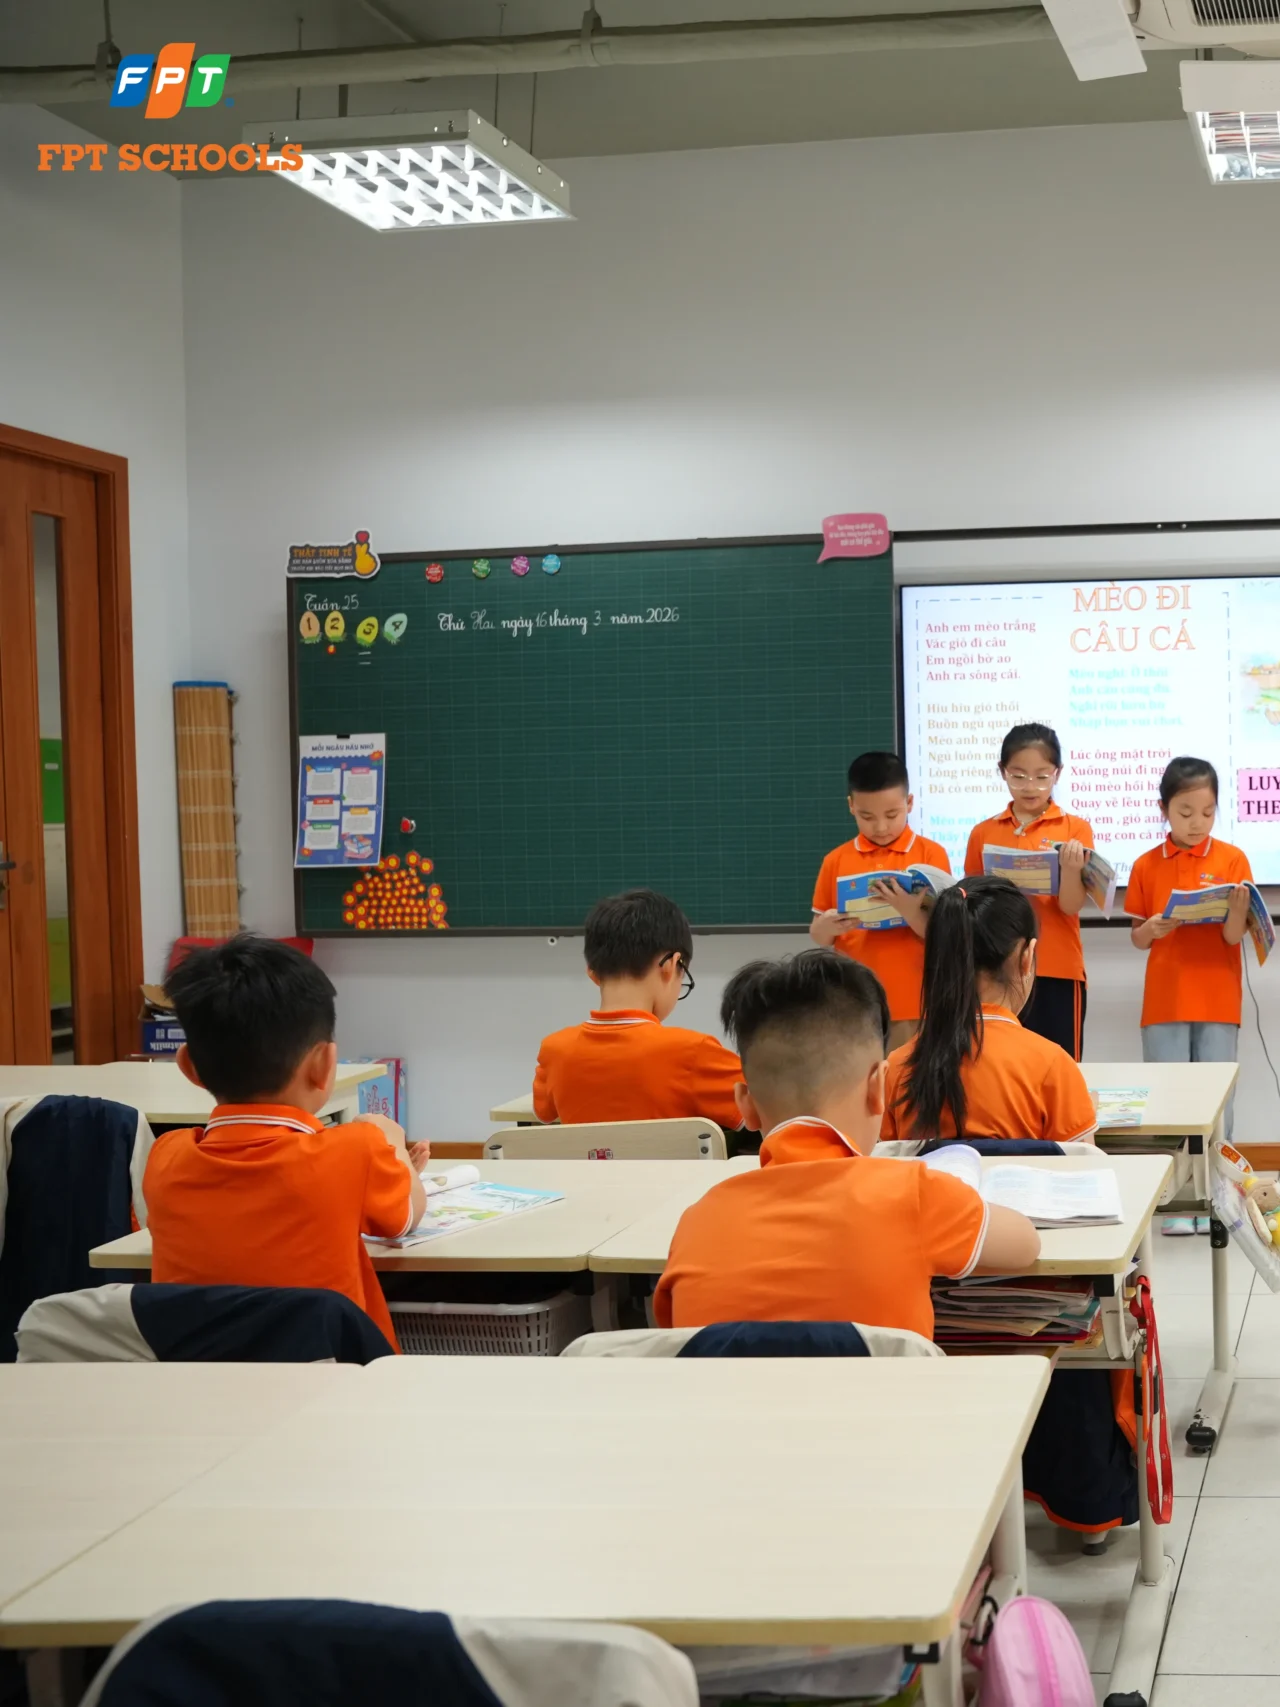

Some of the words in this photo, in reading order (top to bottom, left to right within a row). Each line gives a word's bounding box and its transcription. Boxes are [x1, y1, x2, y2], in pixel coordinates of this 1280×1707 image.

[1073, 580, 1147, 612] MÈO
[1156, 585, 1191, 610] ĐI
[342, 594, 359, 610] 25
[330, 616, 340, 631] 2
[362, 622, 375, 636] 3
[500, 615, 534, 638] ngày
[549, 609, 588, 636] tháng
[593, 610, 602, 627] 3
[610, 611, 644, 625] năm
[645, 606, 680, 624] 2026
[926, 623, 949, 633] Anh
[953, 624, 971, 633] em
[974, 621, 1000, 632] mèo
[1070, 620, 1140, 653] CÂU
[1149, 618, 1196, 651] CÁ
[970, 637, 982, 648] đi
[926, 655, 944, 665] Em
[997, 655, 1011, 664] ao
[926, 670, 950, 681] Anh
[954, 672, 966, 680] ra
[956, 734, 978, 746] anh
[1112, 765, 1131, 775] núi
[1135, 765, 1147, 775] đi
[964, 784, 982, 793] em
[1095, 781, 1121, 792] mèo
[1071, 798, 1102, 811] Quay
[1095, 816, 1113, 824] em
[1115, 832, 1136, 841] con
